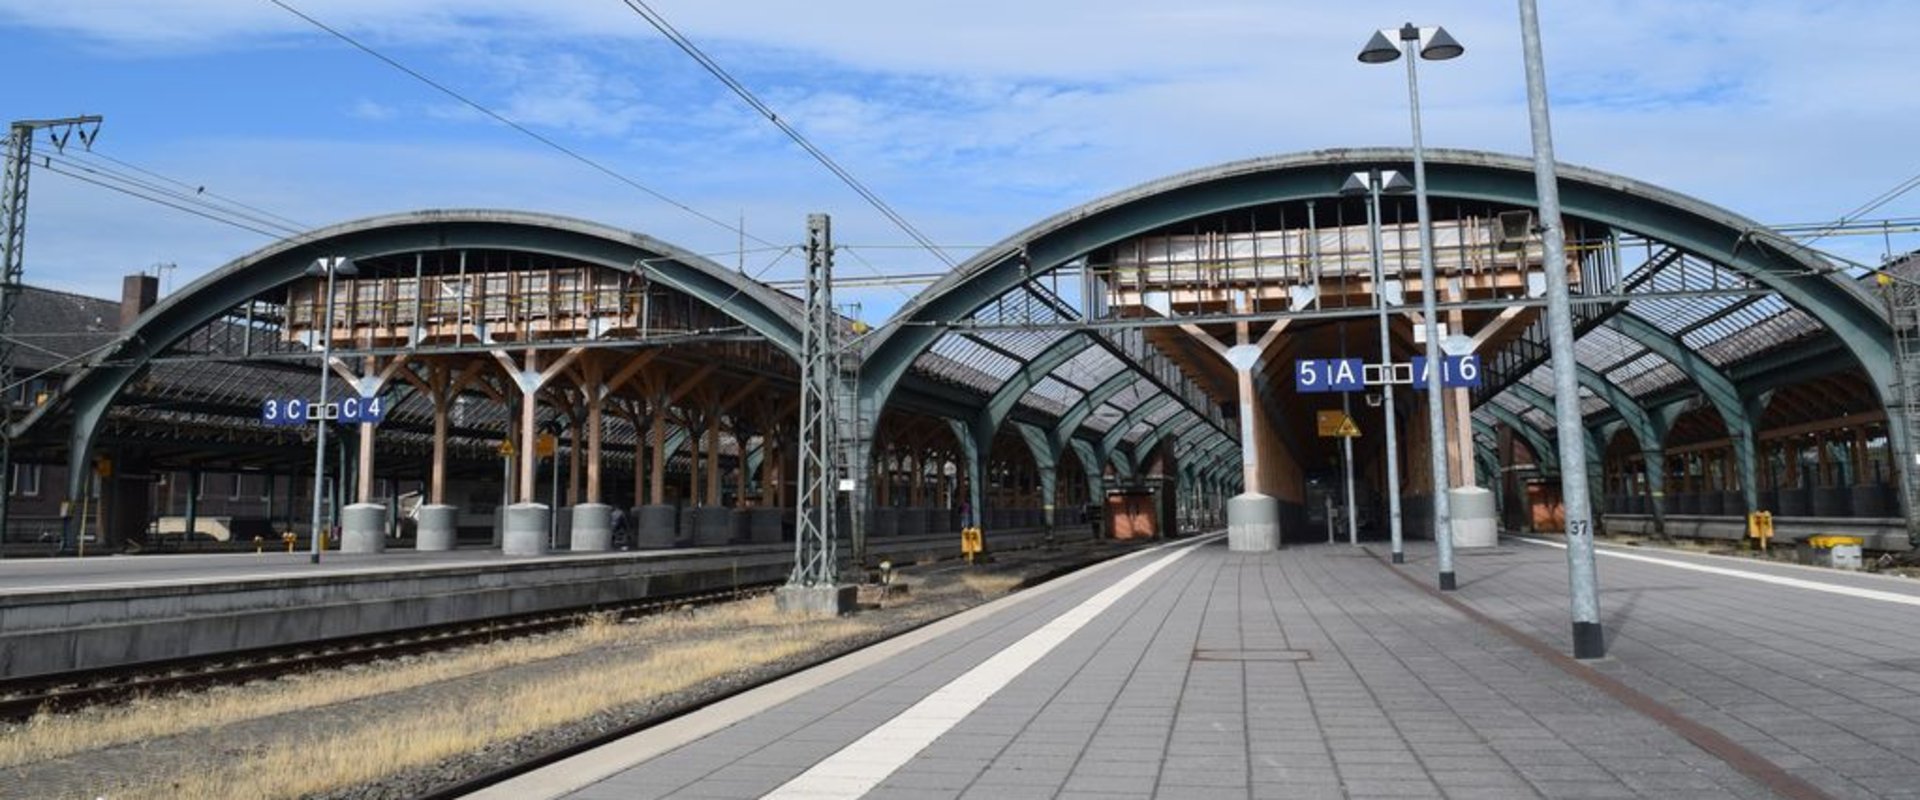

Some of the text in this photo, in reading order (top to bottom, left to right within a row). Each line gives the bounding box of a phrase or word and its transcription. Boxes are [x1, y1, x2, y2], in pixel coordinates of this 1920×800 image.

[1301, 360, 1356, 385] 5 A
[1460, 356, 1476, 380] 6
[265, 400, 301, 419] 3 C
[343, 398, 381, 418] C 4
[1570, 520, 1588, 536] 37
